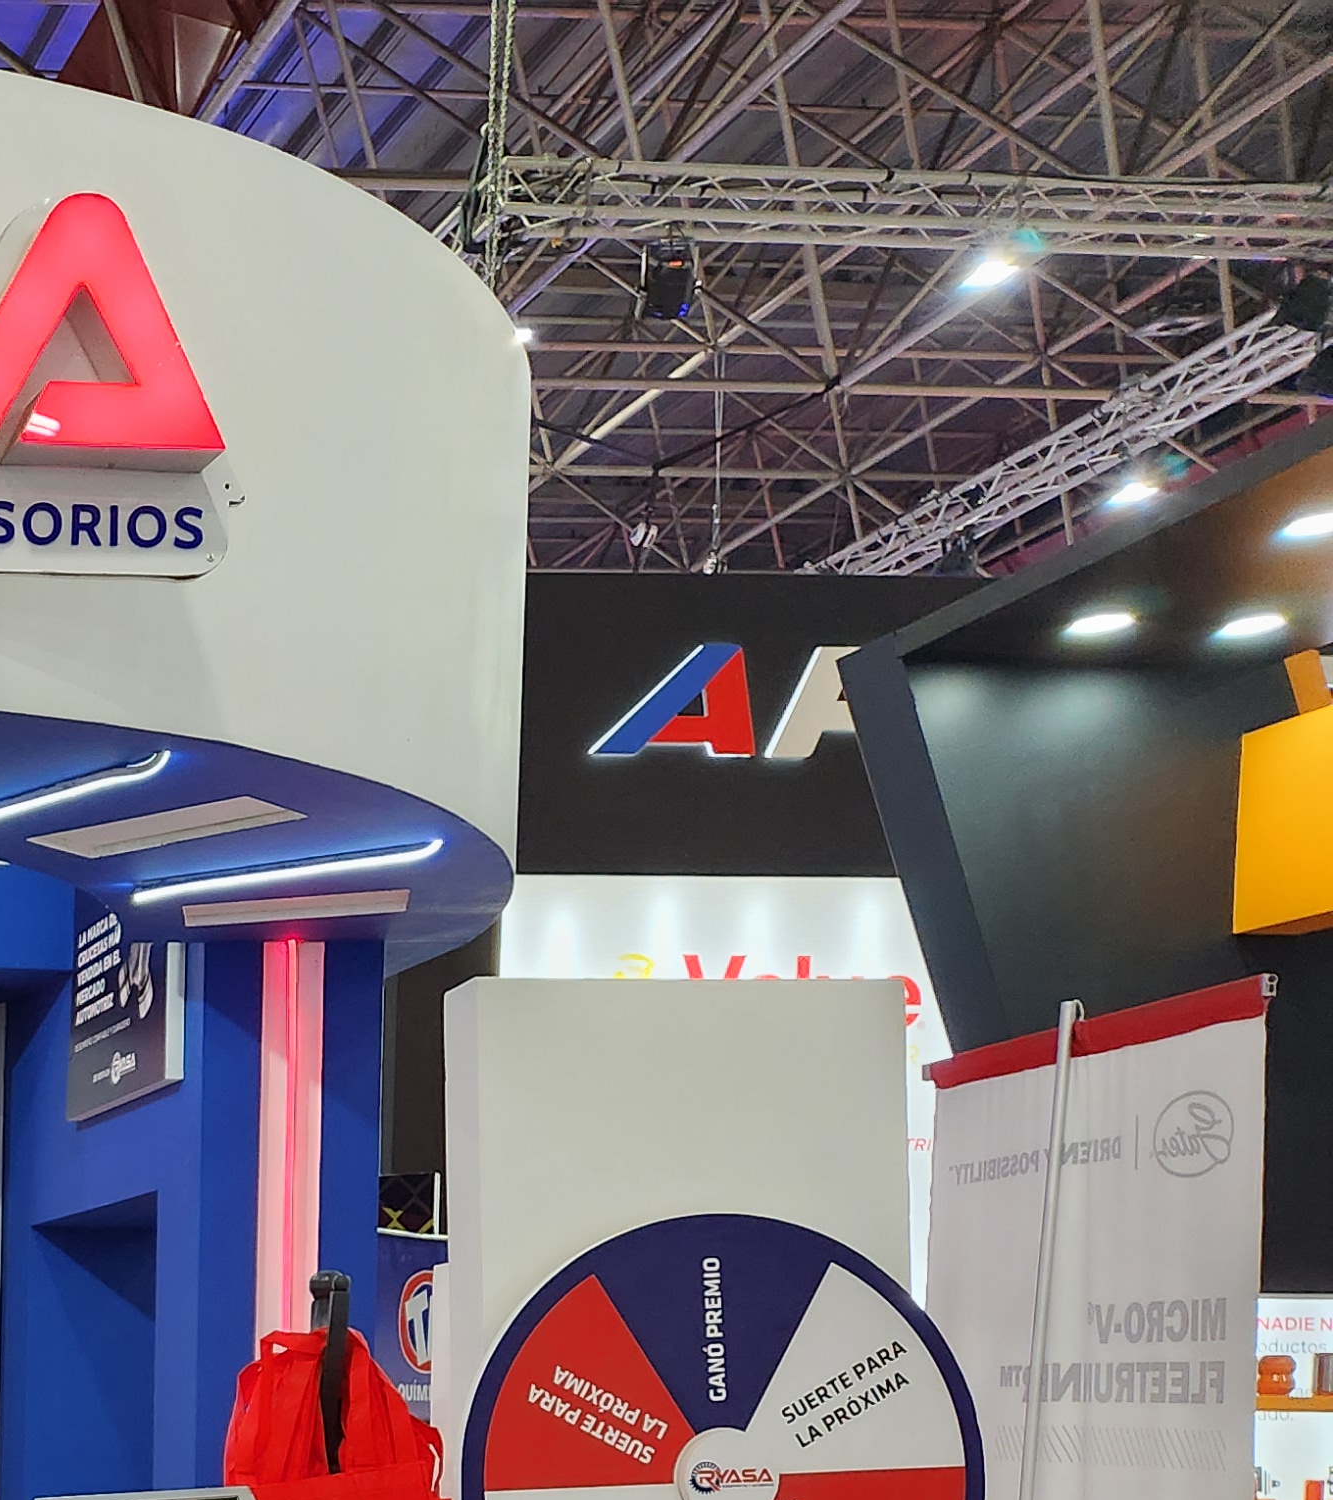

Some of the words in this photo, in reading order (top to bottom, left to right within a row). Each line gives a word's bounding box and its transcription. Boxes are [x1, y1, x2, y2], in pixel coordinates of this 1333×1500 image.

[702, 1257, 722, 1340] PREMIO
[1257, 1316, 1315, 1331] NADIE
[553, 1365, 641, 1426] PRÓXIMA
[706, 1343, 727, 1402] GANÓ
[781, 1371, 853, 1424] SUERTE
[851, 1340, 908, 1381] PARA
[527, 1383, 584, 1426] PARA
[641, 1413, 669, 1440] LA
[795, 1424, 823, 1448] LA
[821, 1372, 910, 1432] PRÓXIMA
[580, 1413, 656, 1464] SUERTE
[697, 1468, 773, 1492] RYASA
